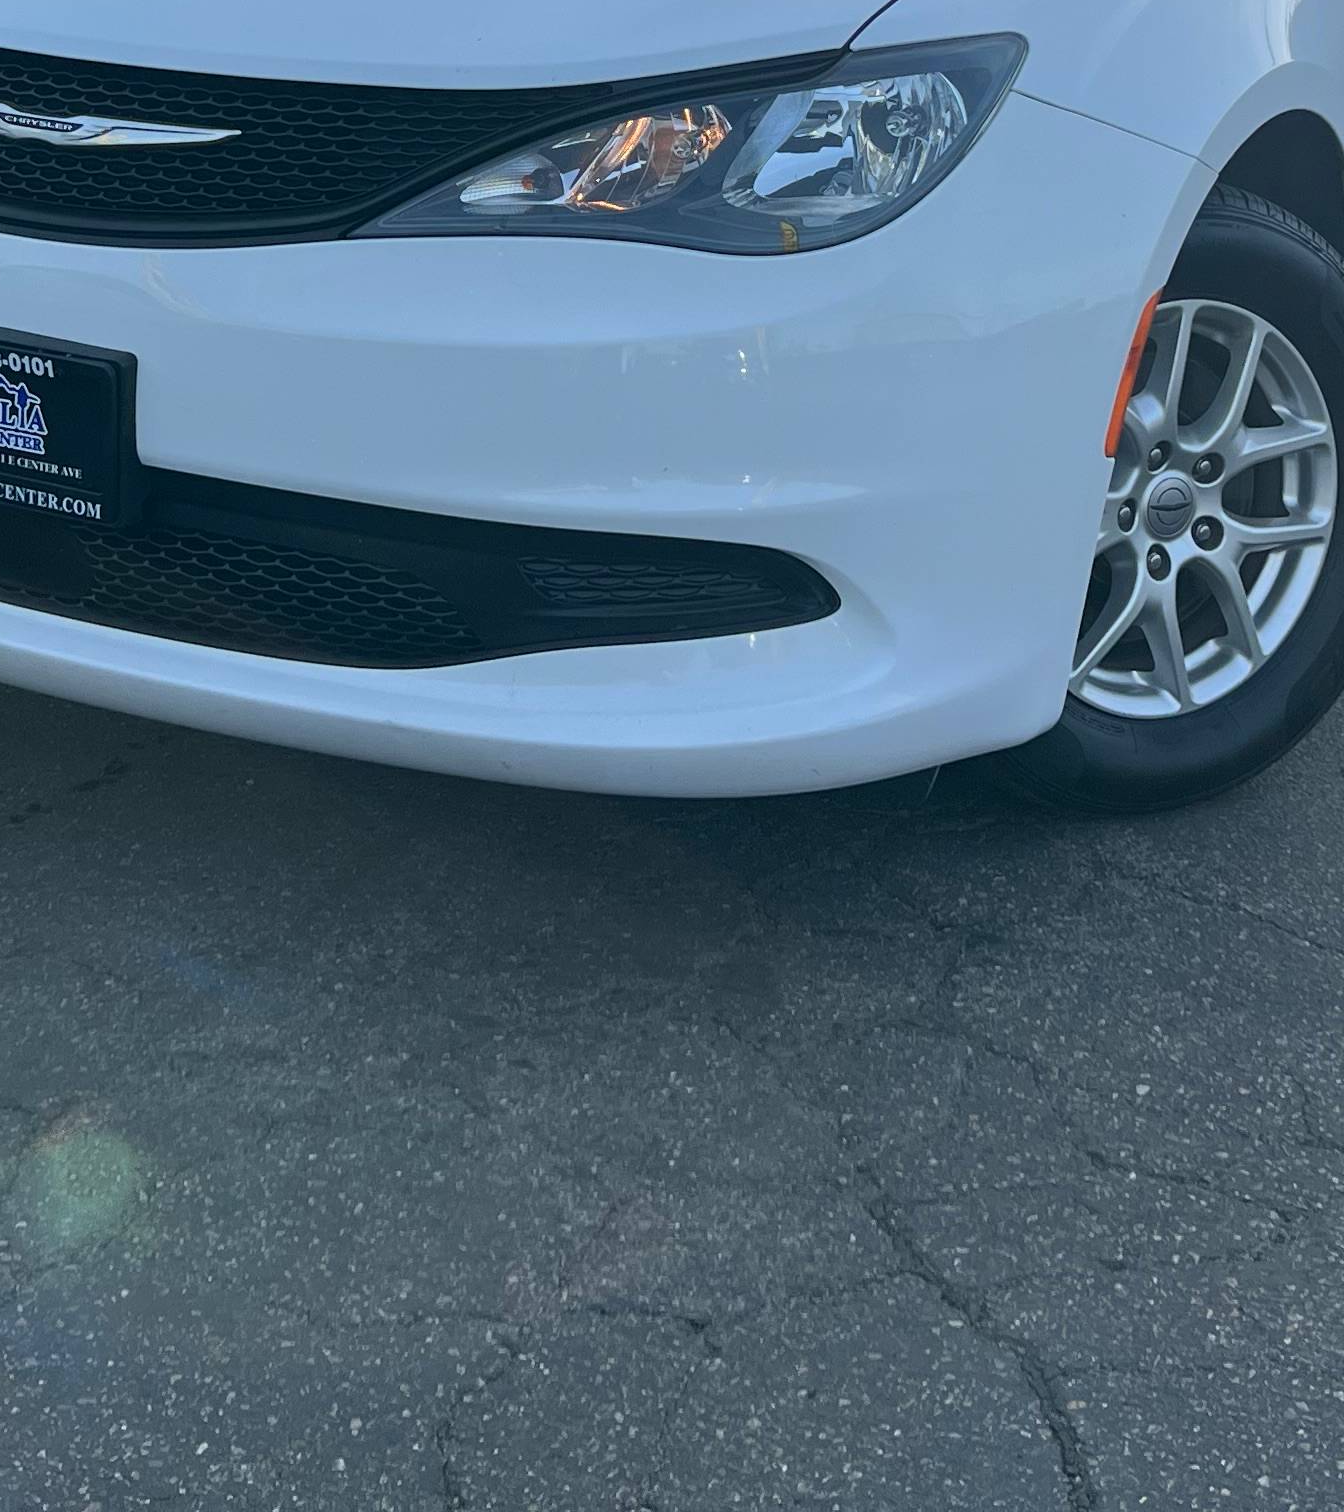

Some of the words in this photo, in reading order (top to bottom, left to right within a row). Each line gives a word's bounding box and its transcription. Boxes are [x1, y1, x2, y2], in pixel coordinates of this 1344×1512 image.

[3, 114, 74, 131] CHRYSLER
[8, 455, 16, 466] E
[16, 457, 59, 475] CENTER
[61, 466, 83, 479] AVE
